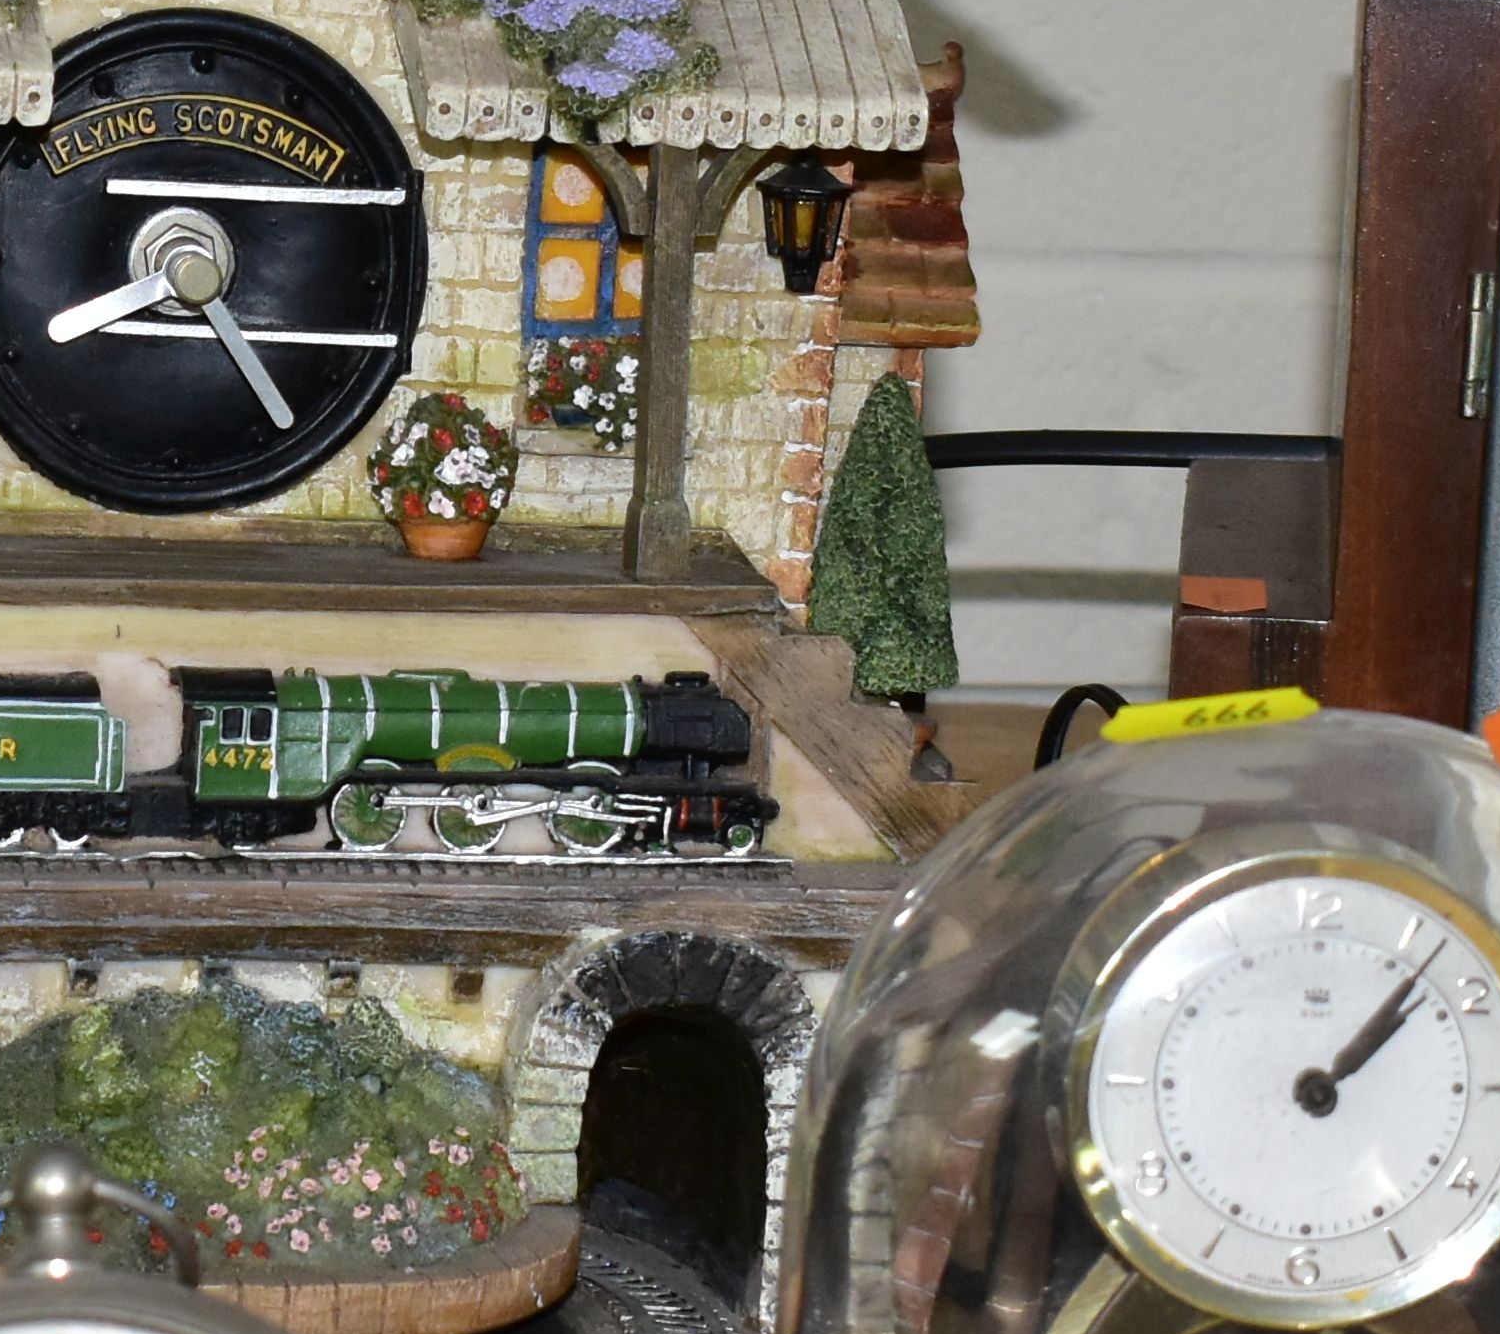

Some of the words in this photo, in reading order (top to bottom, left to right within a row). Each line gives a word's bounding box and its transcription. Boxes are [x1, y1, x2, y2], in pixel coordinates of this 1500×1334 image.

[54, 106, 158, 165] FLYING
[175, 104, 330, 172] SCOTSMAN
[1182, 700, 1271, 728] 666
[203, 745, 277, 771] 4472
[1455, 975, 1491, 1016] 2
[1134, 1150, 1168, 1197] 8
[1445, 1156, 1480, 1198] 4
[1285, 1245, 1321, 1285] 6
